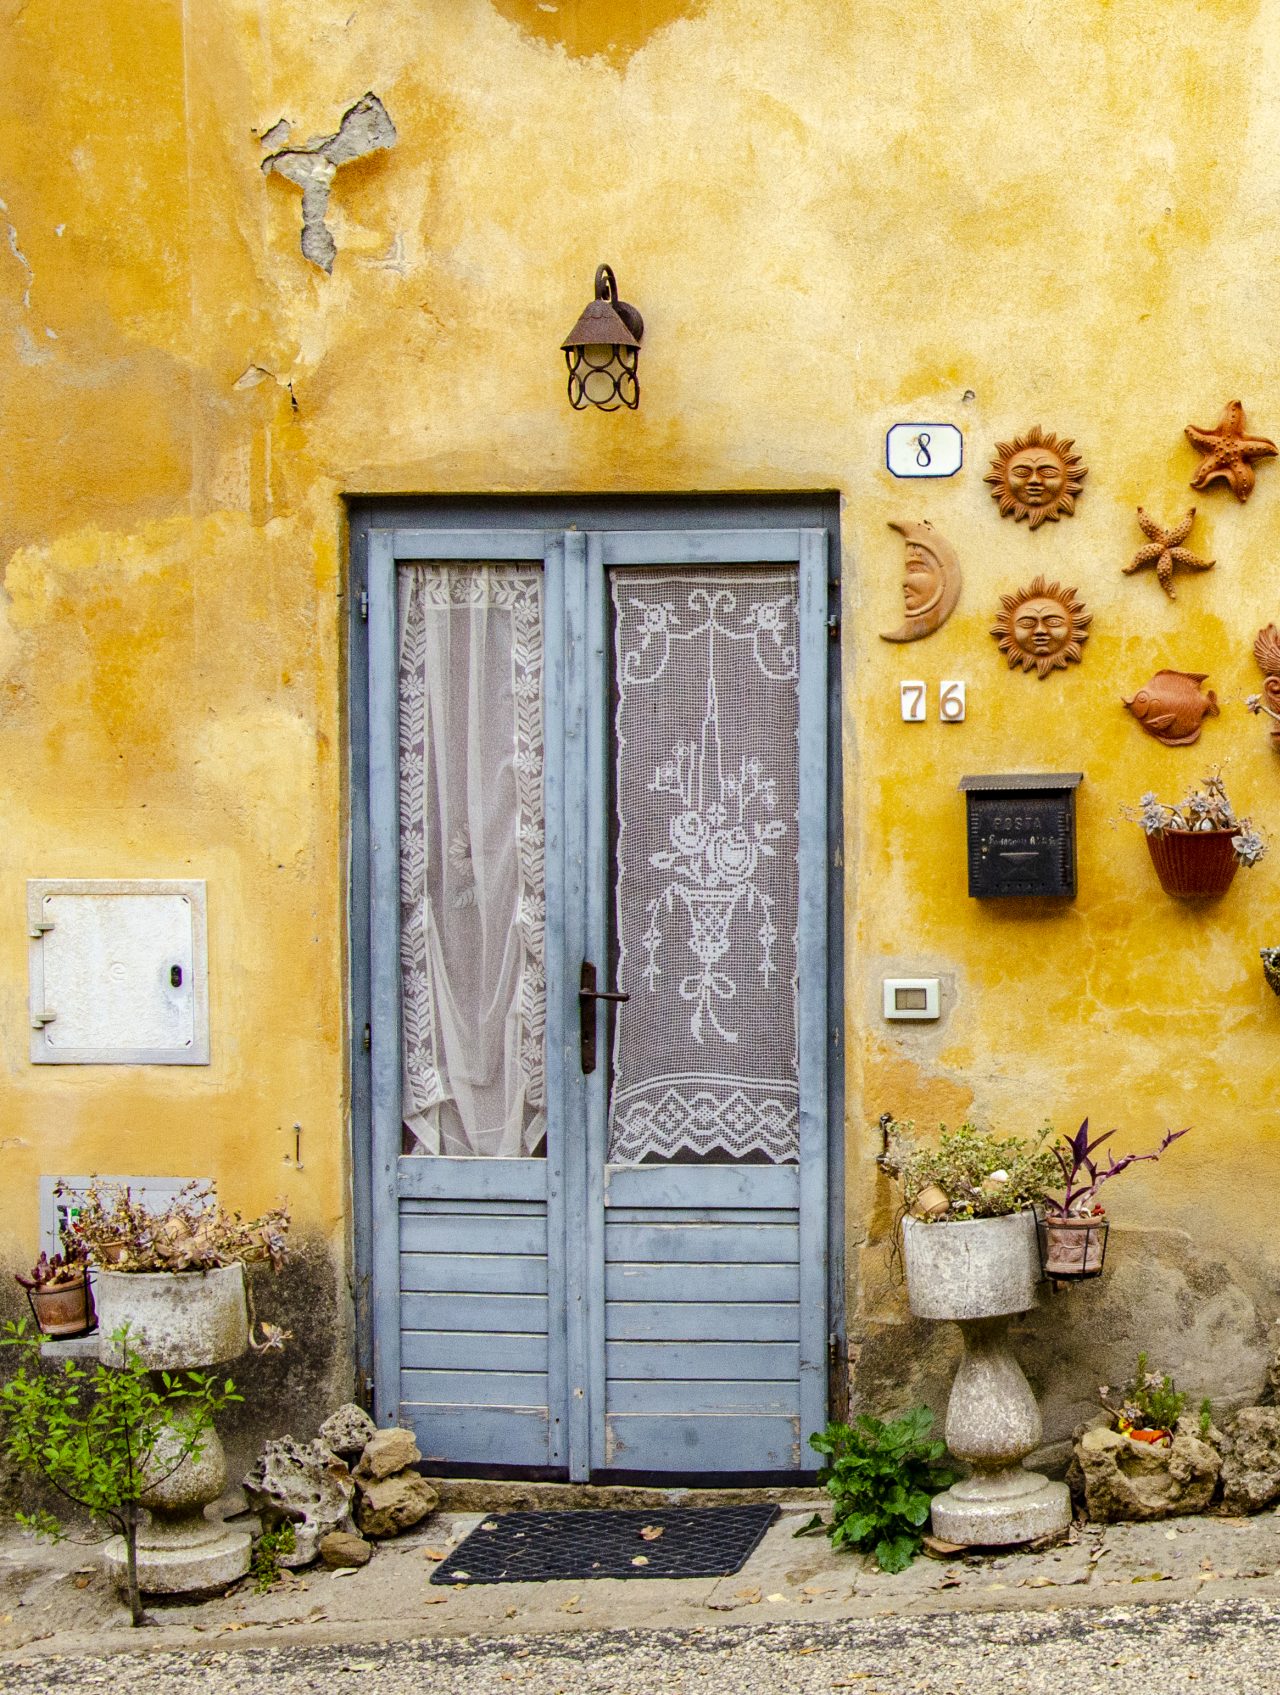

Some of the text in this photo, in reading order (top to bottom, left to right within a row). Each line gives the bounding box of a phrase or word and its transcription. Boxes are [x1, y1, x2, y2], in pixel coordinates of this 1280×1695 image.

[916, 432, 931, 467] 8
[902, 684, 964, 719] 76
[993, 816, 1042, 831] POSTA
